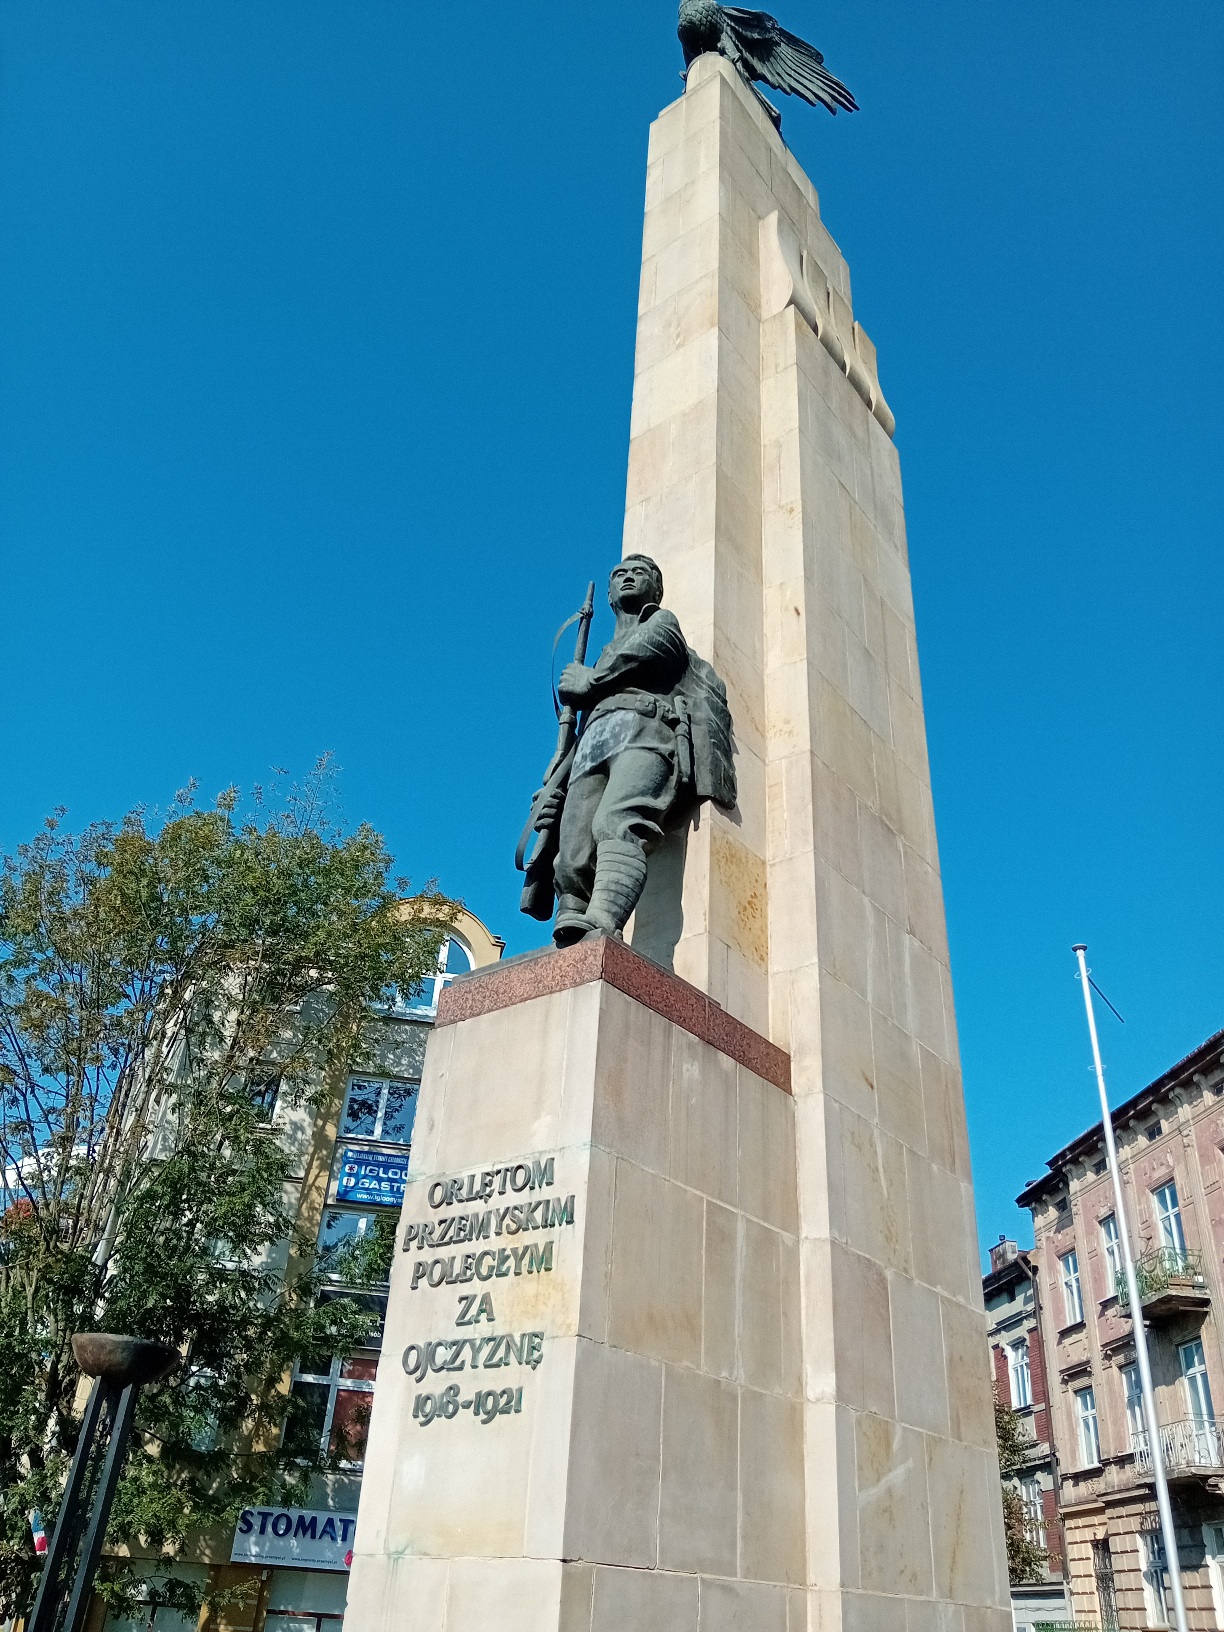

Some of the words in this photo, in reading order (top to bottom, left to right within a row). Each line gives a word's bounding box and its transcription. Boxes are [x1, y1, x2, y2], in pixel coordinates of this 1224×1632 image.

[428, 1157, 554, 1209] ORLĘTOM
[402, 1195, 575, 1252] PRZEMYSKIM
[410, 1241, 554, 1289] POLEGŁYM
[455, 1291, 495, 1326] ZA
[402, 1332, 544, 1383] OJCZYZNĘ
[412, 1384, 523, 1427] 1918-1921
[238, 1509, 356, 1542] STOMAT
